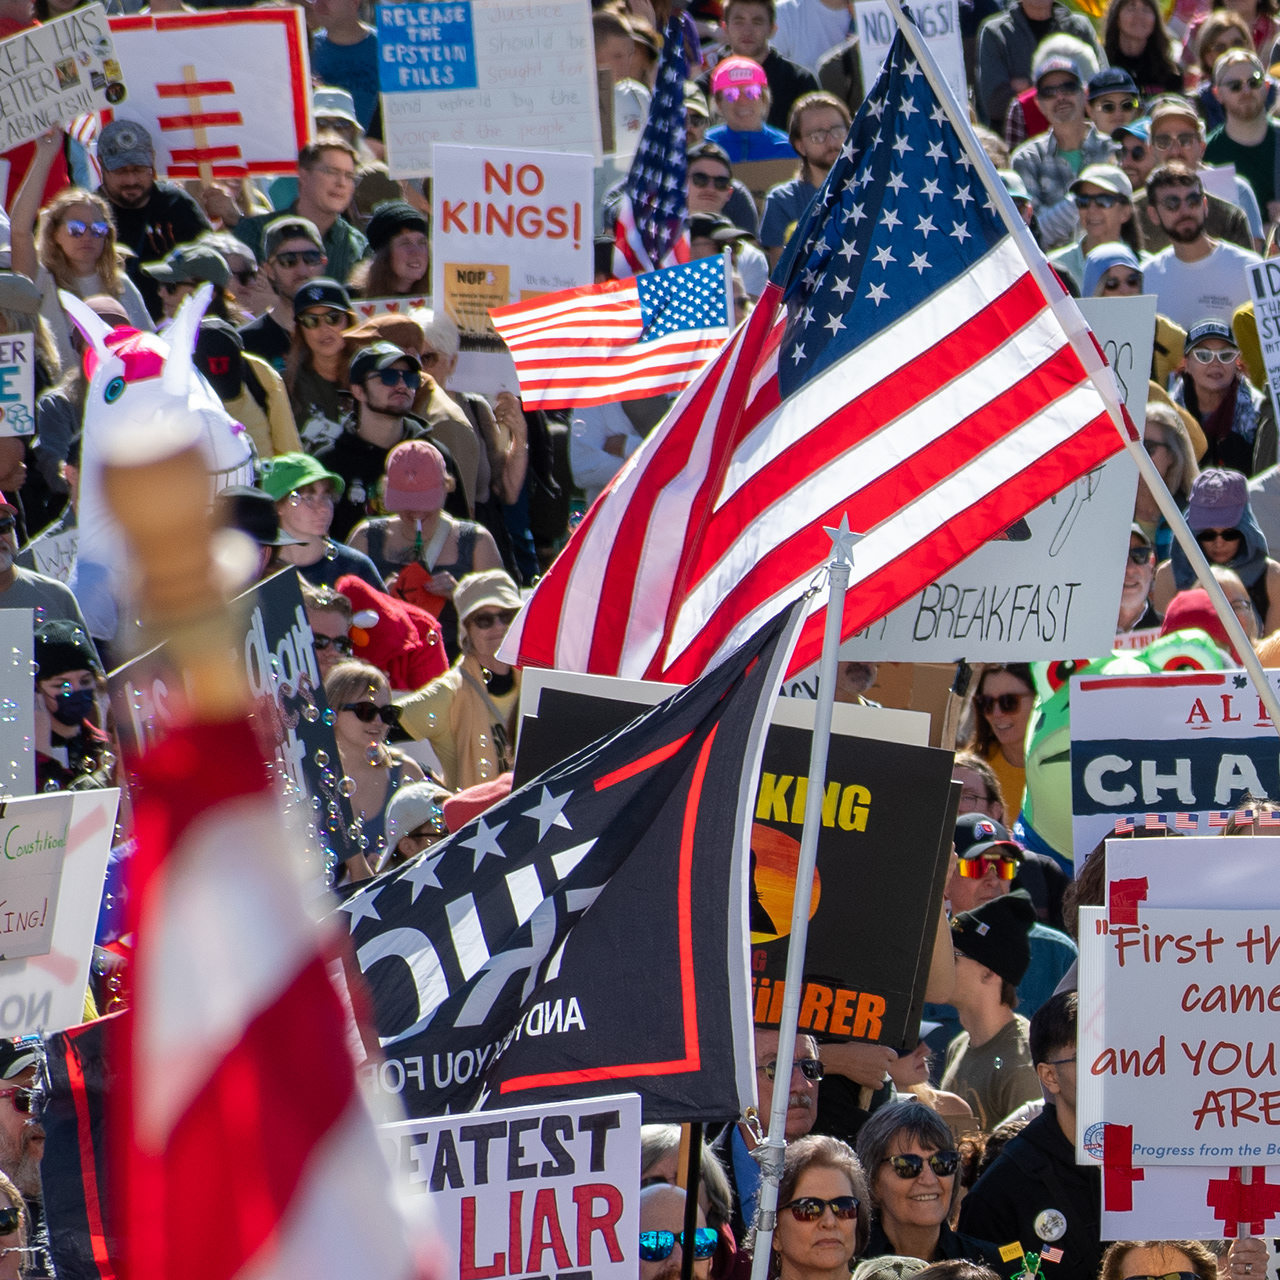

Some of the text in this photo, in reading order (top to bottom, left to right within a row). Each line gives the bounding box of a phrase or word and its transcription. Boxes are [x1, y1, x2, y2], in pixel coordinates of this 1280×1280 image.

[381, 5, 466, 26] RELEASE
[407, 26, 441, 42] THE
[382, 43, 467, 63] EPSTEIN
[398, 65, 455, 86] FILES
[484, 159, 545, 197] NO
[441, 200, 582, 250] KINGS!
[914, 582, 1082, 643] BREAKFAST
[1091, 1035, 1278, 1078] and YOU
[1132, 1143, 1196, 1157] Progress
[1199, 1143, 1234, 1157] from
[1238, 1143, 1261, 1156] the
